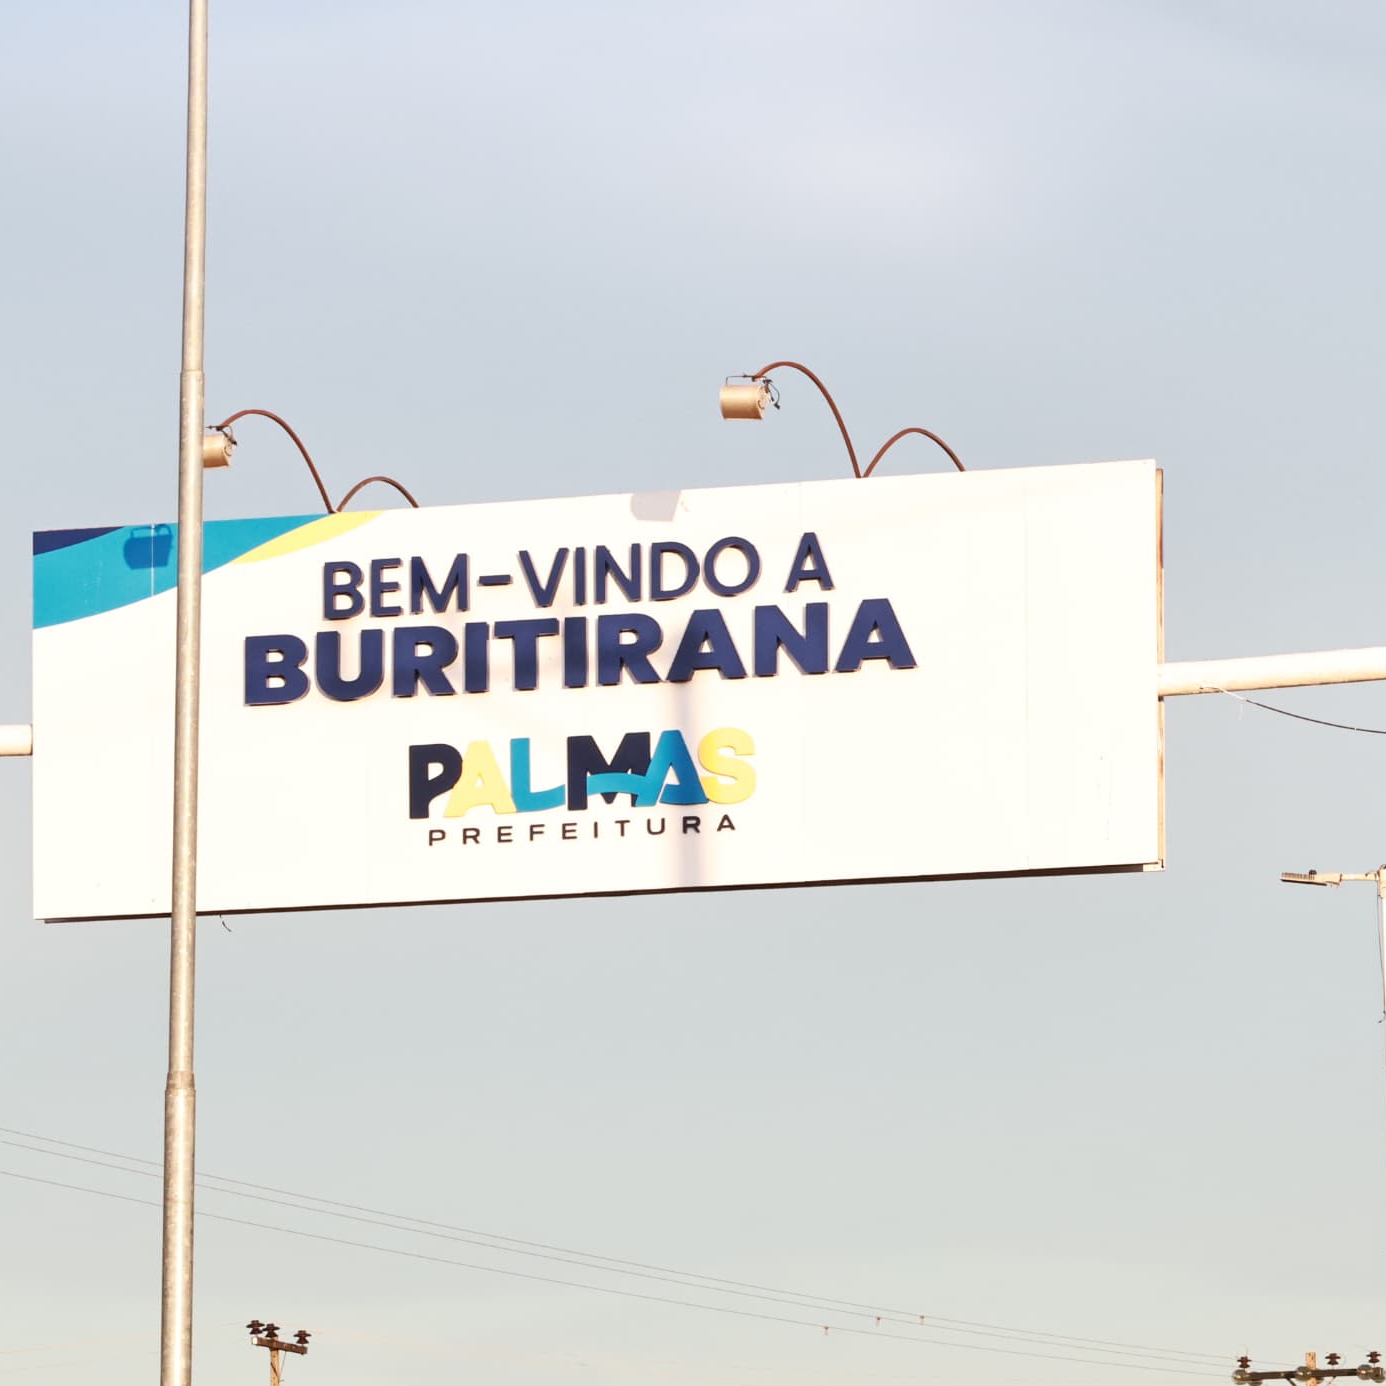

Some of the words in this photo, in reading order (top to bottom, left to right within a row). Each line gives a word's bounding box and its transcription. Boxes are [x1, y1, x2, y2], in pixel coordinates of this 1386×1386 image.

[323, 535, 762, 622] BEM-VINDO
[784, 531, 835, 593] A
[244, 598, 918, 707] BURITIRANA
[409, 727, 757, 820] PALMAS
[428, 814, 736, 847] PREFEITURA
